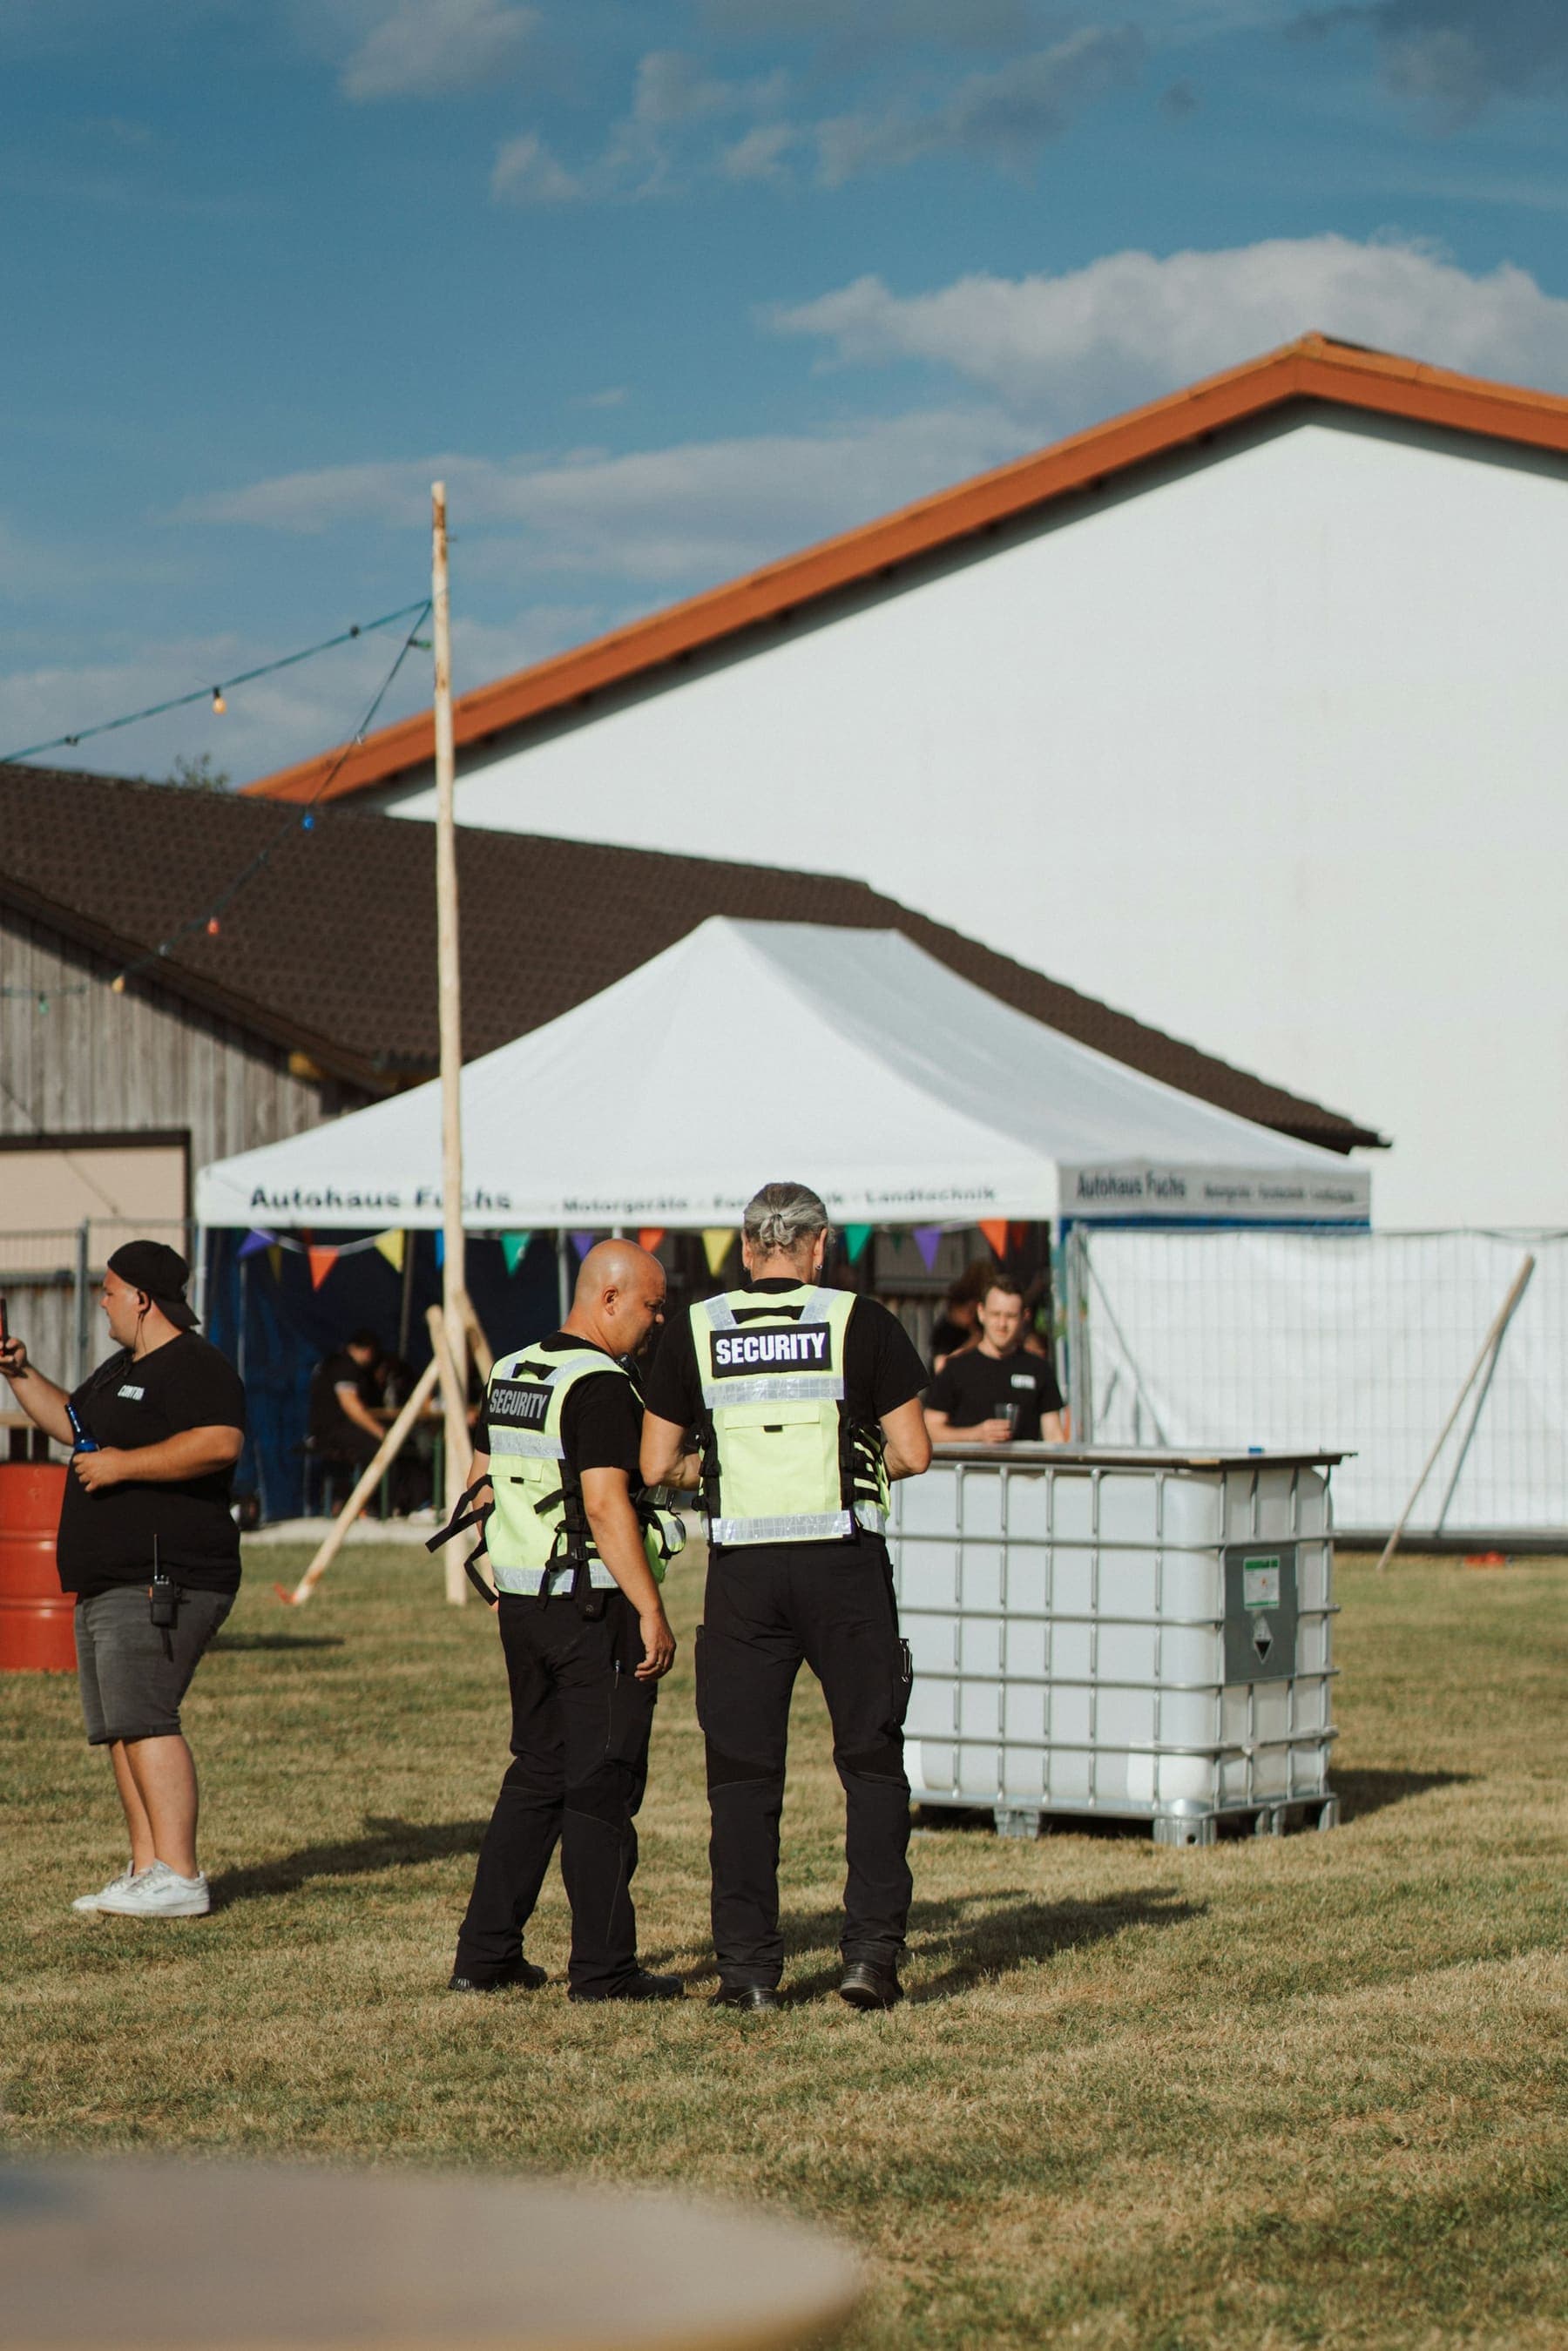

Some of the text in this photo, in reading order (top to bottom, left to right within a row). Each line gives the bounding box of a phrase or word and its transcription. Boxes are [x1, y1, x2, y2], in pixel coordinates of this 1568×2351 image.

[250, 1186, 401, 1209] Autohaus
[1077, 1171, 1143, 1198] Autohaus
[715, 1332, 826, 1365] SECURITY
[490, 1388, 548, 1419] SECURITY
